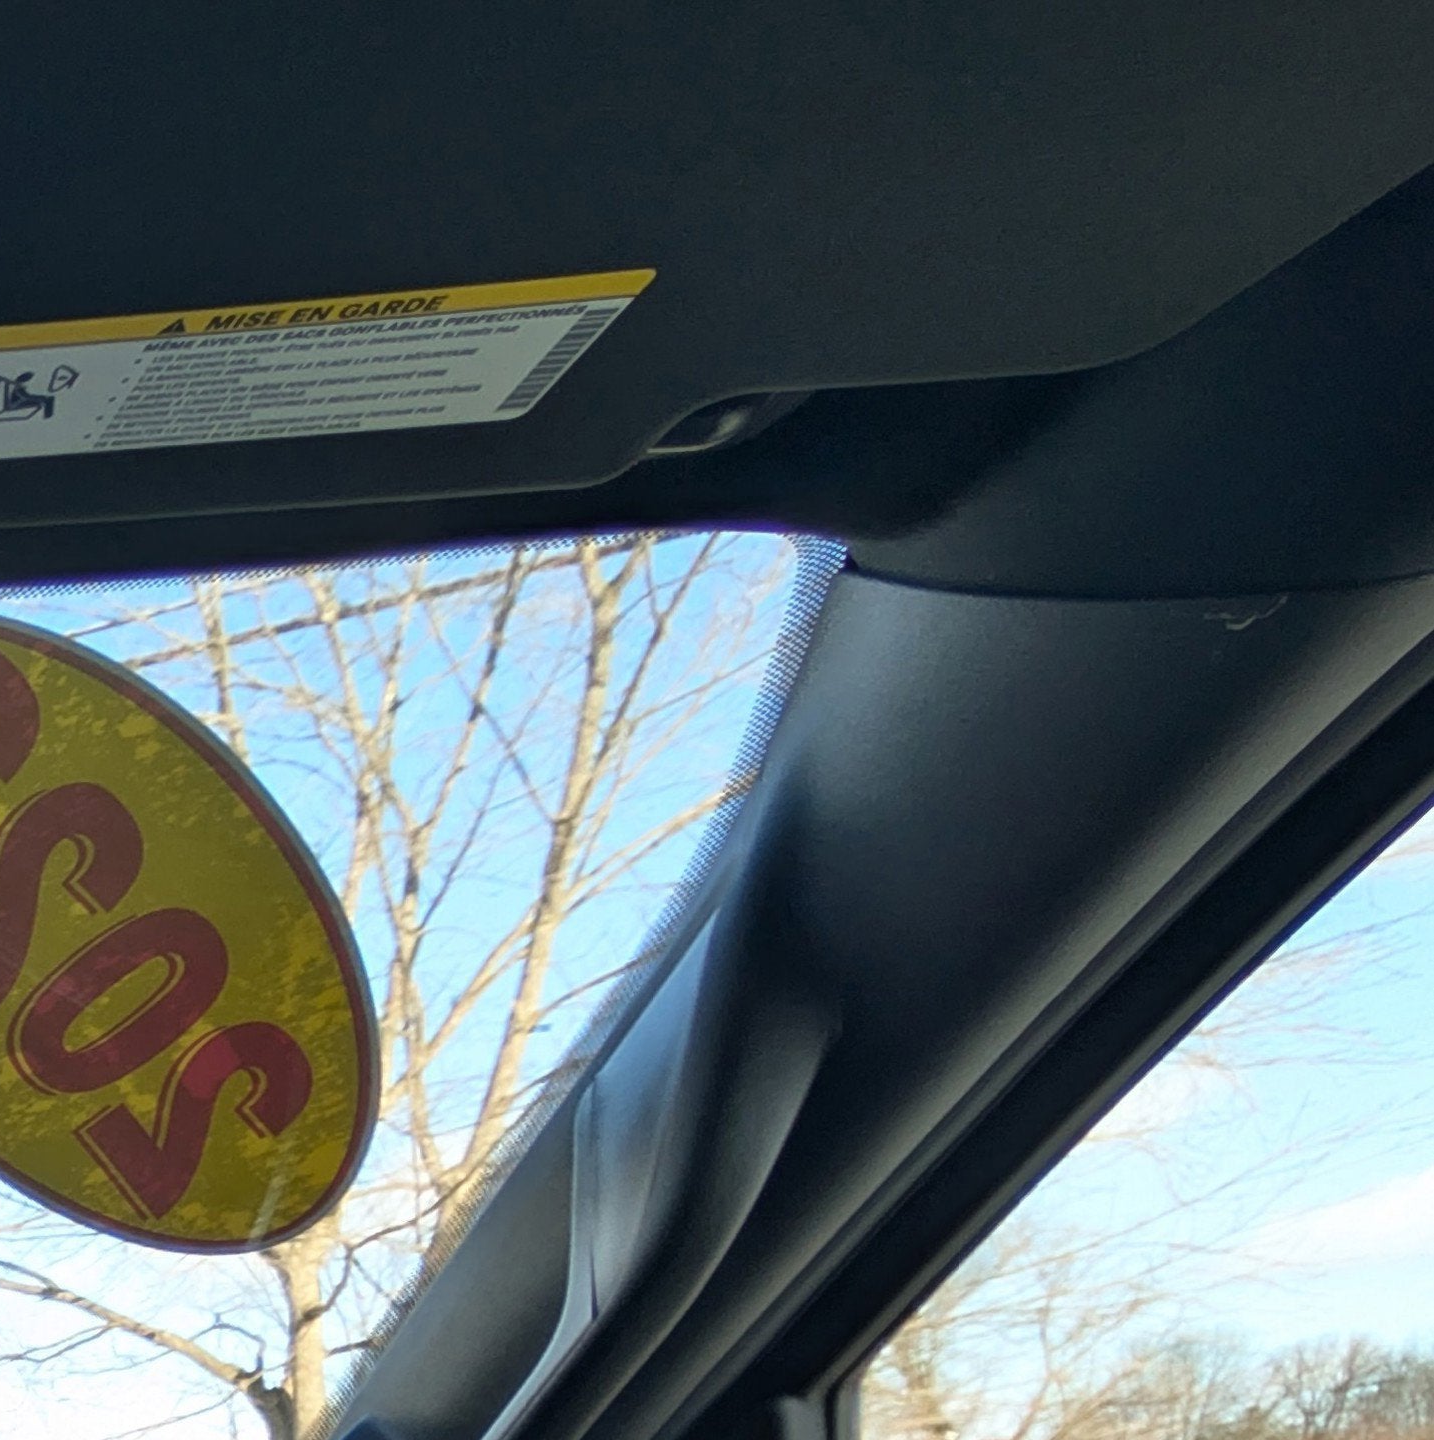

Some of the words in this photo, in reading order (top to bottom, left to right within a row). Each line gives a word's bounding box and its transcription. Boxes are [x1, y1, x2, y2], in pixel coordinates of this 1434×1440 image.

[204, 309, 290, 332] MISE
[287, 305, 335, 324] EN
[338, 295, 449, 319] GARDE
[197, 336, 243, 348] AVEC
[245, 332, 281, 344] DES
[281, 328, 327, 341] SACS
